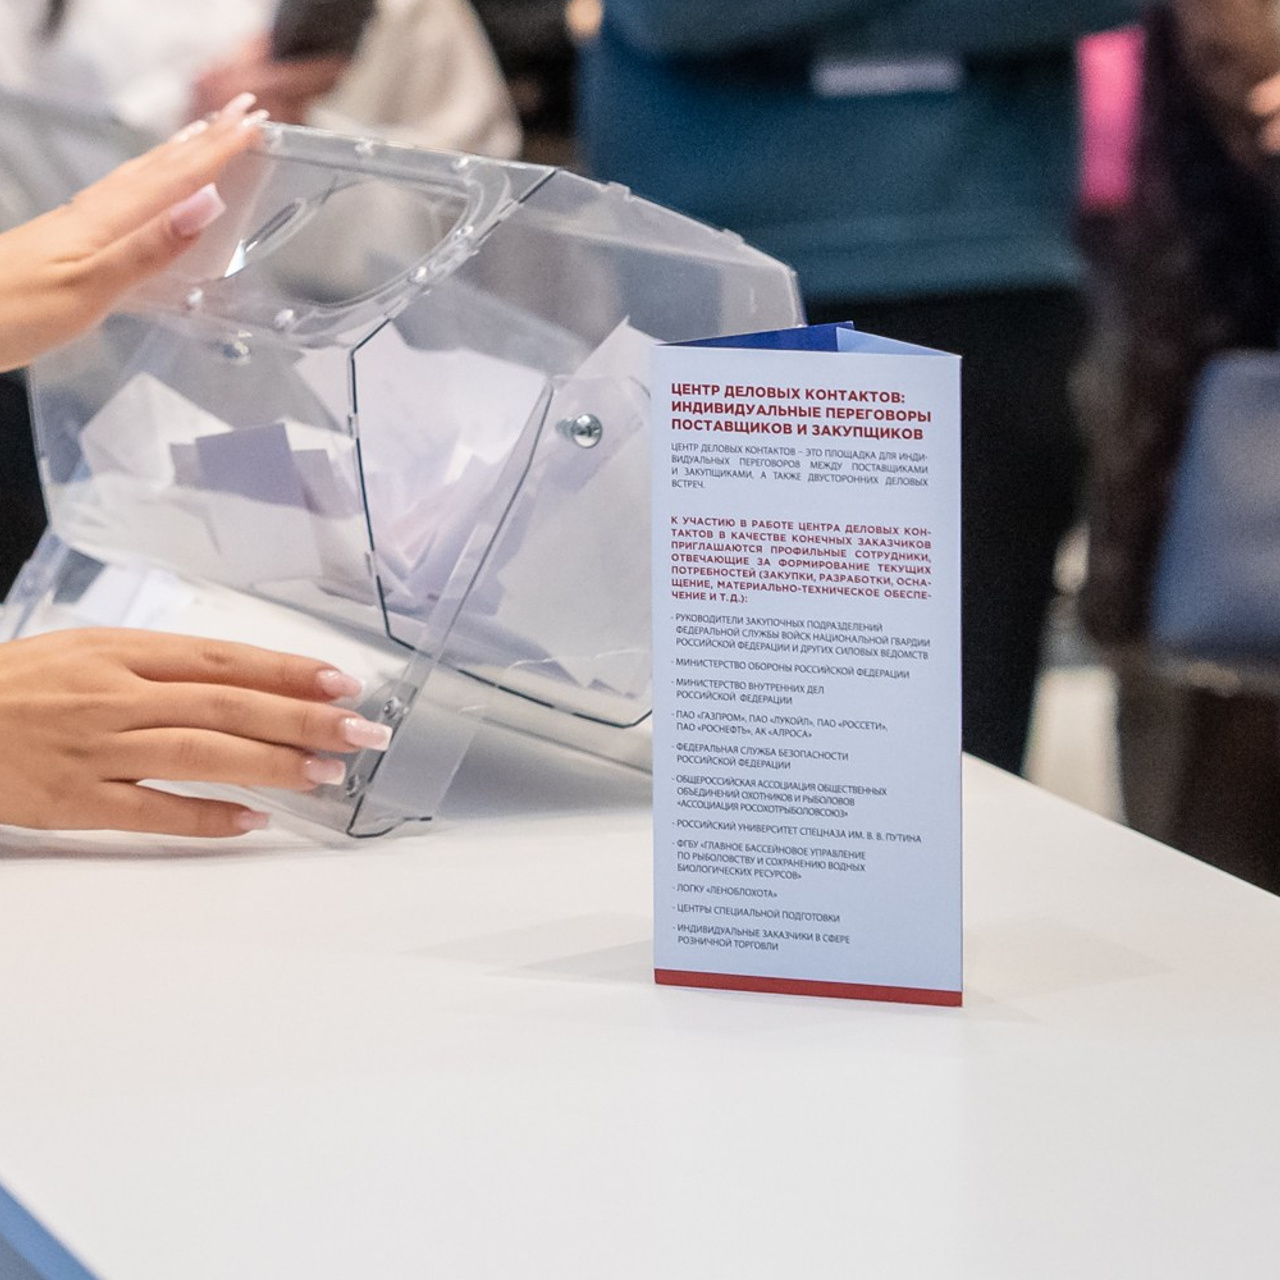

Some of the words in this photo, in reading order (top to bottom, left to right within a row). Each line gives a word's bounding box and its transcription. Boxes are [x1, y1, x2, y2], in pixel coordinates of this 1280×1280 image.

[671, 383, 720, 396] ЦЕНТР
[724, 385, 801, 399] ДЕЛОВЫХ
[805, 388, 905, 403] КОНТАКТОВ:
[672, 400, 821, 418] ИНДИВИДУАЛЬНЫЕ
[826, 407, 931, 422] ПЕРЕГОВОРЫ
[672, 418, 793, 434] ПОСТАВЩИКОВ
[797, 424, 807, 435] И
[812, 424, 923, 440] ЗАКУПЩИКОВ
[671, 442, 699, 452] ЦЕНТР
[700, 443, 743, 453] ДЕЛОВЫХ
[745, 445, 796, 456] КОНТАКТОВ
[805, 447, 823, 457] ЭТО
[825, 448, 877, 460] ПЛОЩАДКА
[878, 451, 897, 460] ДЛЯ
[899, 452, 927, 462] ИНДИ-
[671, 454, 730, 465] ВИДУАЛЬНЫХ
[739, 457, 801, 468] ПЕРЕГОВОРОВ
[810, 460, 843, 471] МЕЖДУ
[851, 462, 928, 474] ПОСТАВЩИКАМИ
[671, 467, 678, 475] И
[760, 470, 766, 479] А
[772, 471, 801, 481] ТАКЖЕ
[807, 473, 879, 483] ДВУСТОРОННИХ
[885, 476, 928, 486] ДЕЛОВЫХ
[671, 516, 678, 524] К
[682, 516, 736, 527] УЧАСТИЮ
[740, 519, 747, 528] В
[752, 519, 794, 529] РАБОТЕ
[798, 522, 841, 532] ЦЕНТРА
[845, 524, 899, 535] ДЕЛОВЫХ
[904, 527, 931, 536] КОН-
[671, 528, 714, 539] ТАКТОВ
[719, 530, 726, 539] В
[731, 531, 786, 542] КАЧЕСТВЕ
[792, 534, 852, 545] КОНЕЧНЫХ
[858, 537, 931, 549] ЗАКАЗЧИКОВ
[671, 540, 762, 553] ПРИГЛАШАЮТСЯ
[771, 545, 847, 557] ПРОФИЛЬНЫЕ
[854, 550, 931, 563] СОТРУДНИКИ,
[671, 552, 749, 565] ОТВЕЧАЮЩИЕ
[757, 557, 771, 566] ЗА
[778, 558, 870, 571] ФОРМИРОВАНИЕ
[877, 563, 931, 574] ТЕКУЩИХ
[671, 565, 756, 578] ПОТРЕБНОСТЕЙ
[759, 570, 816, 582] (ЗАКУПКИ,
[819, 573, 894, 586] РАЗРАБОТКИ,
[896, 577, 931, 587] ОСНА-
[671, 578, 713, 589] ЩЕНИЕ,
[717, 580, 880, 597] МАТЕРИАЛЬНО-ТЕХНИЧЕСКОЕ
[884, 588, 931, 599] ОБЕСПЕ-
[671, 590, 706, 601] ЧЕНИЕ
[709, 591, 717, 601] И
[675, 613, 744, 625] РУКОВОДИТЕЛИ
[745, 616, 805, 628] ЗАКУПОЧНЫХ
[807, 619, 883, 632] ПОДРАЗДЕЛЕНИЙ
[676, 625, 741, 636] ФЕДЕРАЛЬНОЙ
[741, 628, 780, 639] СЛУЖБЫ
[781, 630, 811, 641] ВОЙСК
[813, 633, 889, 645] НАЦИОНАЛЬНОЙ
[890, 636, 931, 647] ГВАРДИИ
[676, 637, 736, 648] РОССИЙСКОЙ
[737, 641, 790, 652] ФЕДЕРАЦИИ
[792, 643, 799, 652] И
[800, 644, 834, 654] ДРУГИХ
[835, 646, 879, 656] СИЛОВЫХ
[880, 648, 929, 660] ВЕДОМСТВ
[676, 657, 747, 669] МИНИСТЕРСТВО
[748, 661, 793, 672] ОБОРОНЫ
[794, 664, 854, 675] РОССИЙСКОЙ
[856, 667, 910, 679] ФЕДЕРАЦИИ
[676, 677, 747, 690] МИНИСТЕРСТВО
[748, 681, 805, 693] ВНУТРЕННИХ
[807, 684, 824, 695] ДЕЛ
[676, 689, 737, 701] РОССИЙСКОЙ
[738, 693, 793, 705] ФЕДЕРАЦИИ
[676, 709, 696, 719] ПАО
[749, 714, 768, 723] ПАО
[817, 718, 837, 728] ПАО
[676, 721, 696, 731] ПАО
[754, 727, 767, 735] АК
[768, 728, 812, 738] «АЛРОСА»
[676, 742, 739, 754] ФЕДЕРАЛЬНАЯ
[740, 746, 777, 756] СЛУЖБА
[778, 748, 848, 761] БЕЗОПАСНОСТИ
[676, 754, 736, 766] РОССИЙСКОЙ
[738, 758, 791, 770] ФЕДЕРАЦИИ
[676, 774, 756, 787] ОБЩЕРОССИЙСКАЯ
[757, 779, 816, 792] АССОЦИАЦИЯ
[817, 783, 887, 795] ОБЩЕСТВЕННЫХ
[676, 786, 740, 798] ОБЪЕДИНЕНИЙ
[741, 790, 793, 802] ОХОТНИКОВ
[794, 794, 801, 802] И
[802, 794, 855, 806] РЫБОЛОВОВ
[677, 818, 736, 830] РОССИЙСКИЙ
[738, 822, 798, 834] УНИВЕРСИТЕТ
[799, 826, 846, 838] СПЕЦНАЗА
[886, 832, 921, 842] ПУТИНА
[676, 839, 699, 848] ФГБУ
[700, 840, 744, 852] «ГЛАВНОЕ
[745, 843, 809, 856] БАССЕЙНОВОЕ
[809, 847, 866, 859] УПРАВЛЕНИЕ
[677, 851, 691, 860] ПО
[692, 852, 756, 865] РЫБОЛОВСТВУ
[757, 856, 764, 865] И
[765, 857, 826, 869] СОХРАНЕНИЮ
[828, 861, 866, 871] ВОДНЫХ
[677, 862, 752, 876] БИОЛОГИЧЕСКИХ
[677, 883, 705, 893] ЛОГКУ
[677, 903, 712, 913] ЦЕНТРЫ
[713, 905, 780, 919] СПЕЦИАЛЬНОЙ
[782, 910, 840, 922] ПОДГОТОВКИ
[677, 923, 760, 938] ИНДИВИДУАЛЬНЫЕ
[762, 929, 814, 941] ЗАКАЗЧИКИ
[815, 933, 821, 942] В
[822, 933, 850, 944] СФЕРЕ
[677, 935, 732, 947] РОЗНИЧНОЙ
[733, 939, 779, 950] ТОРГОВЛИ
